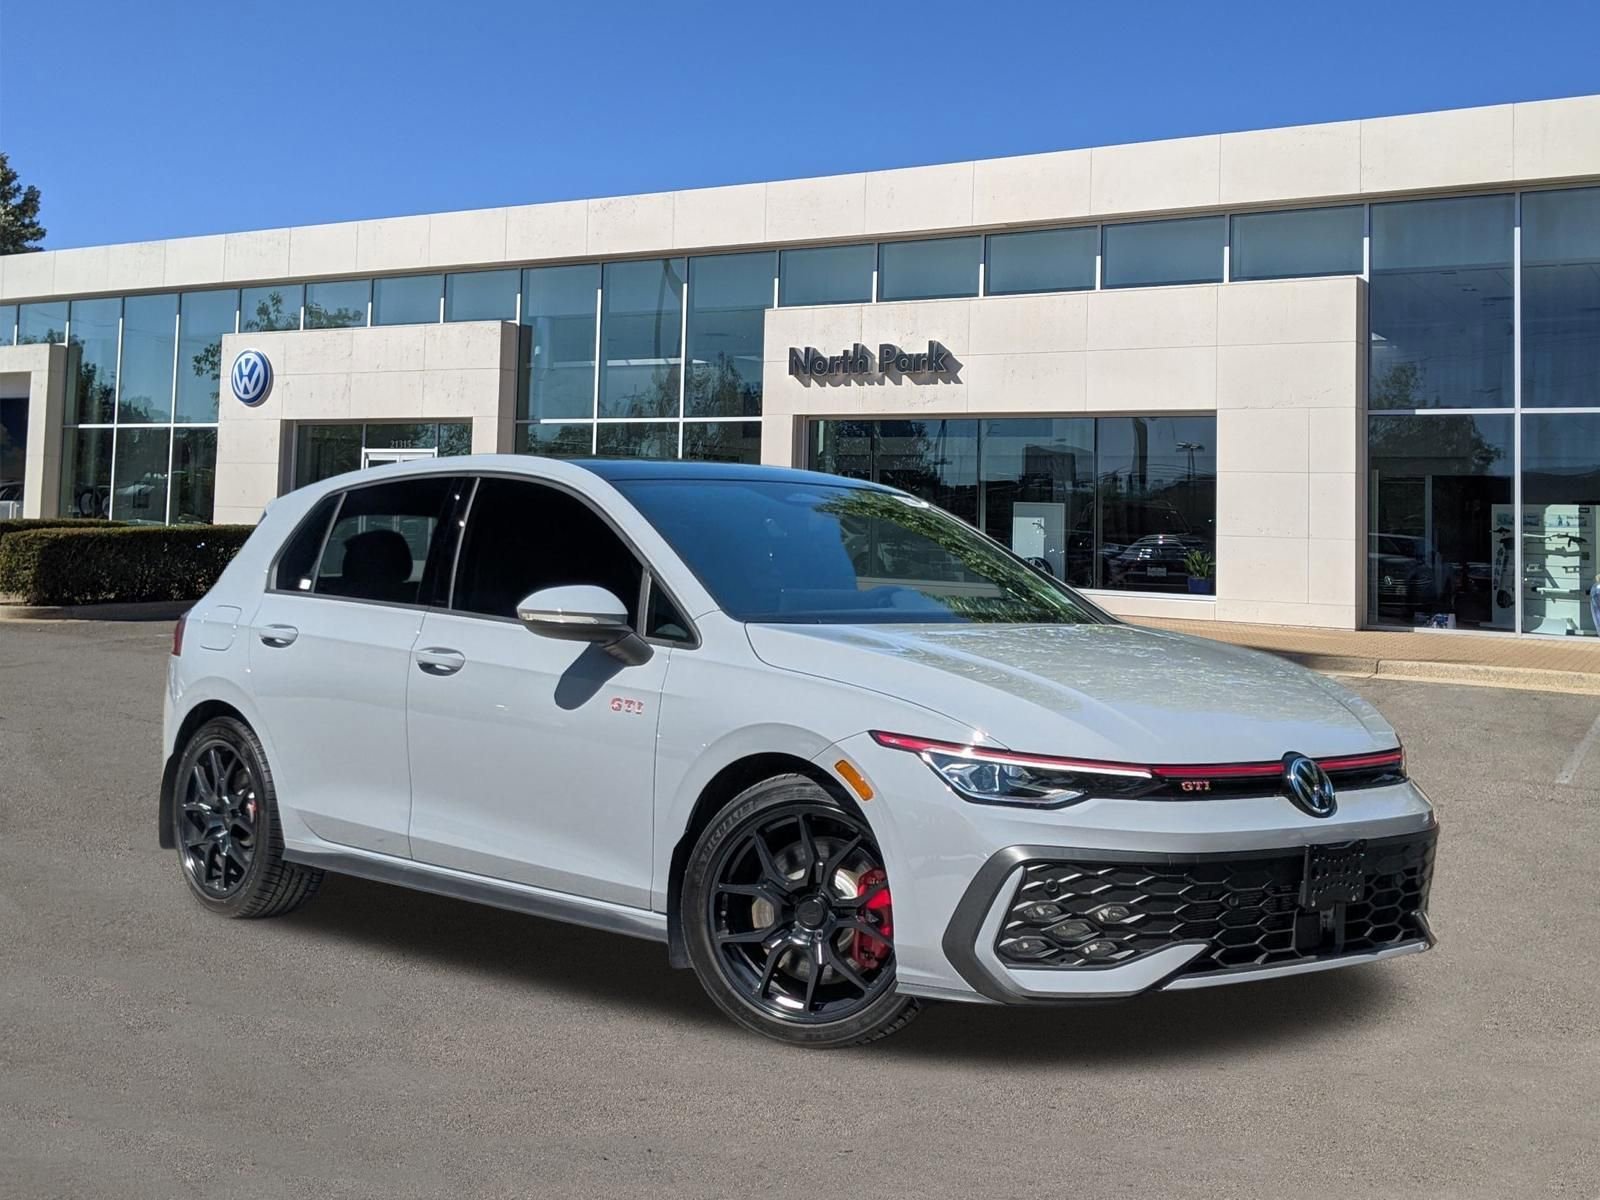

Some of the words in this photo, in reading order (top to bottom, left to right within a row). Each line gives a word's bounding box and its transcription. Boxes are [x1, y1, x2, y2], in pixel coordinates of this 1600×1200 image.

[788, 343, 872, 376] North
[879, 340, 948, 373] Park
[611, 697, 644, 715] GTI
[1181, 780, 1211, 792] GTI
